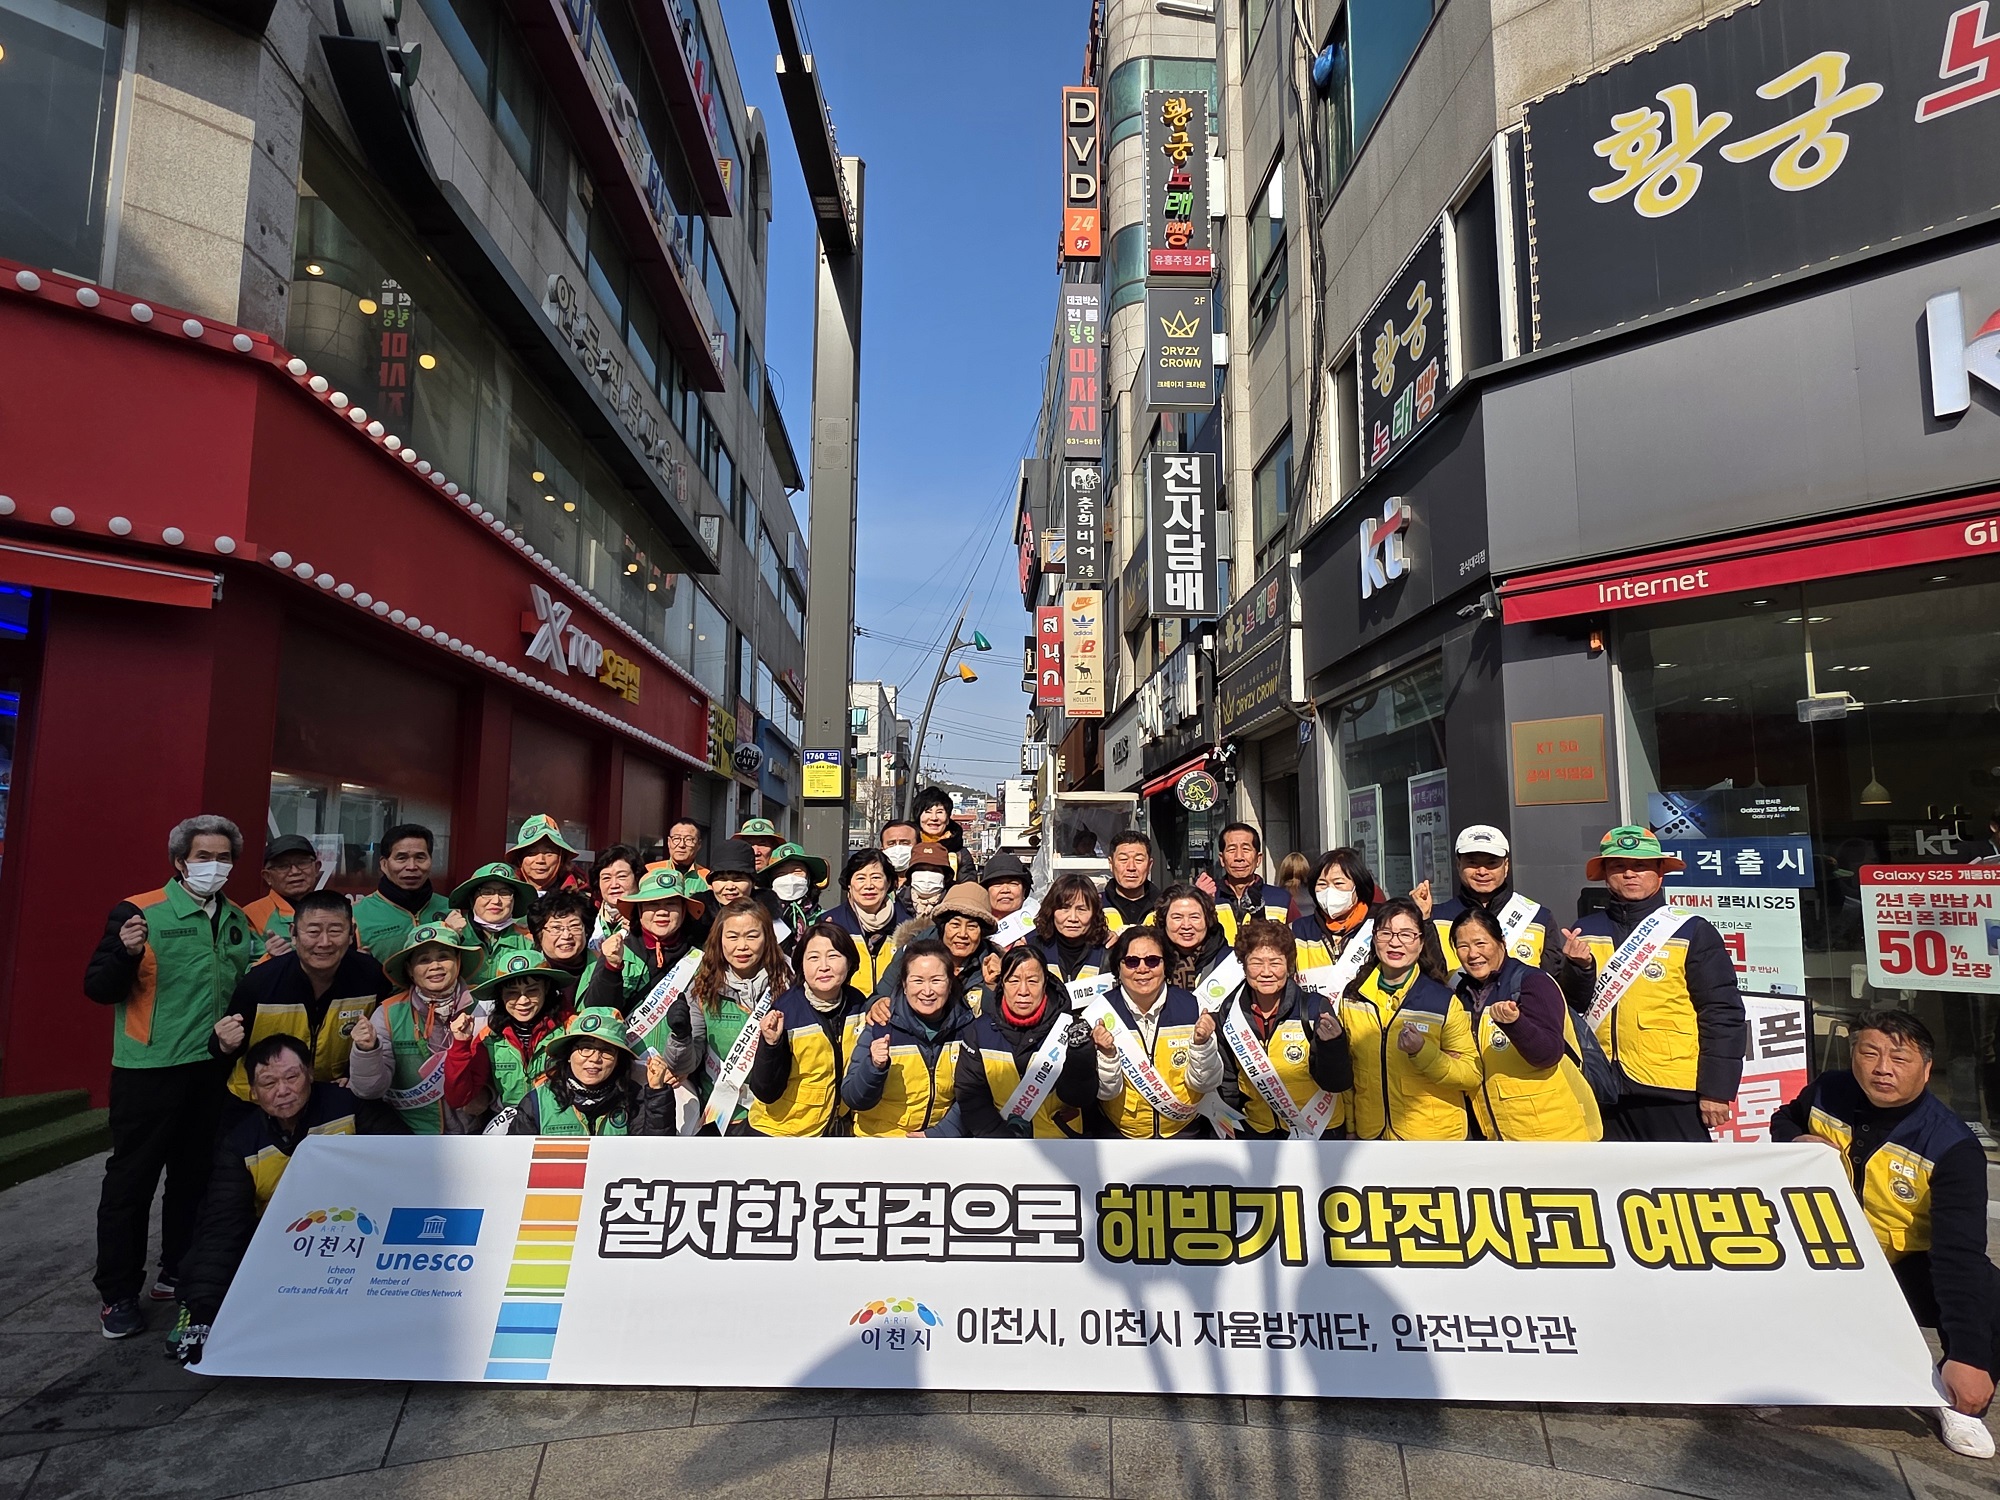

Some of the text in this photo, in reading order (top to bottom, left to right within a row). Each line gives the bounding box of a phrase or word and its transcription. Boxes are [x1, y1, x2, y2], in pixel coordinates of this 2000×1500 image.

[1588, 50, 1884, 219] 황궁
[1068, 98, 1097, 201] DVD
[1070, 215, 1095, 232] 24
[1076, 239, 1090, 249] 3F
[1154, 255, 1210, 266] 유흥주점 2F
[1194, 297, 1206, 305] 2F
[1069, 320, 1095, 344] 힐링
[1372, 279, 1433, 398] 황궁
[1161, 346, 1199, 356] CRAZY
[1159, 358, 1202, 369] CROWN
[1069, 348, 1098, 432] 마사지
[1371, 356, 1439, 468] 노래빵
[1076, 496, 1095, 560] 춘희비어
[1163, 456, 1206, 611] 전자담배
[1360, 496, 1411, 599] kt
[1078, 565, 1095, 577] 2층
[1599, 569, 1709, 604] Internet
[1075, 597, 1093, 605] NIKE
[525, 584, 572, 676] X
[566, 624, 604, 677] TOP
[1536, 741, 1553, 754] KT
[736, 757, 757, 766] CAFE
[1413, 793, 1421, 804] KT
[1740, 806, 1765, 814] Galaxy
[1916, 829, 1958, 855] kt
[1873, 870, 1925, 882] Galaxy
[1928, 870, 1953, 880] S25
[1669, 895, 1796, 910] KT에서 갤럭시 S25
[1875, 893, 1993, 909] 2년 후 반납 시
[1876, 910, 1978, 927] 쓰던 폰 최대
[1607, 917, 1660, 973] 안전신문고로
[1619, 941, 1657, 983] 생활주변
[1749, 965, 1756, 973] 후
[1758, 966, 1779, 974] 반납시
[1952, 962, 1992, 979] 보장
[1745, 1012, 1805, 1061] 폰
[600, 1180, 1866, 1272] 철저한 점검으로 해빙기 안전사고 예방 !!
[293, 1235, 365, 1259] 이천시
[327, 1265, 356, 1275] Icheon
[376, 1252, 475, 1272] unesco
[326, 1276, 353, 1286] City of
[369, 1276, 411, 1286] Member of
[277, 1286, 349, 1296] Crafts and Folk Art
[366, 1287, 463, 1298] the Creative Cities Network
[860, 1327, 932, 1352] 이천시
[956, 1306, 1578, 1356] 이천시, 이천시 자율방재단, 안전보안관
